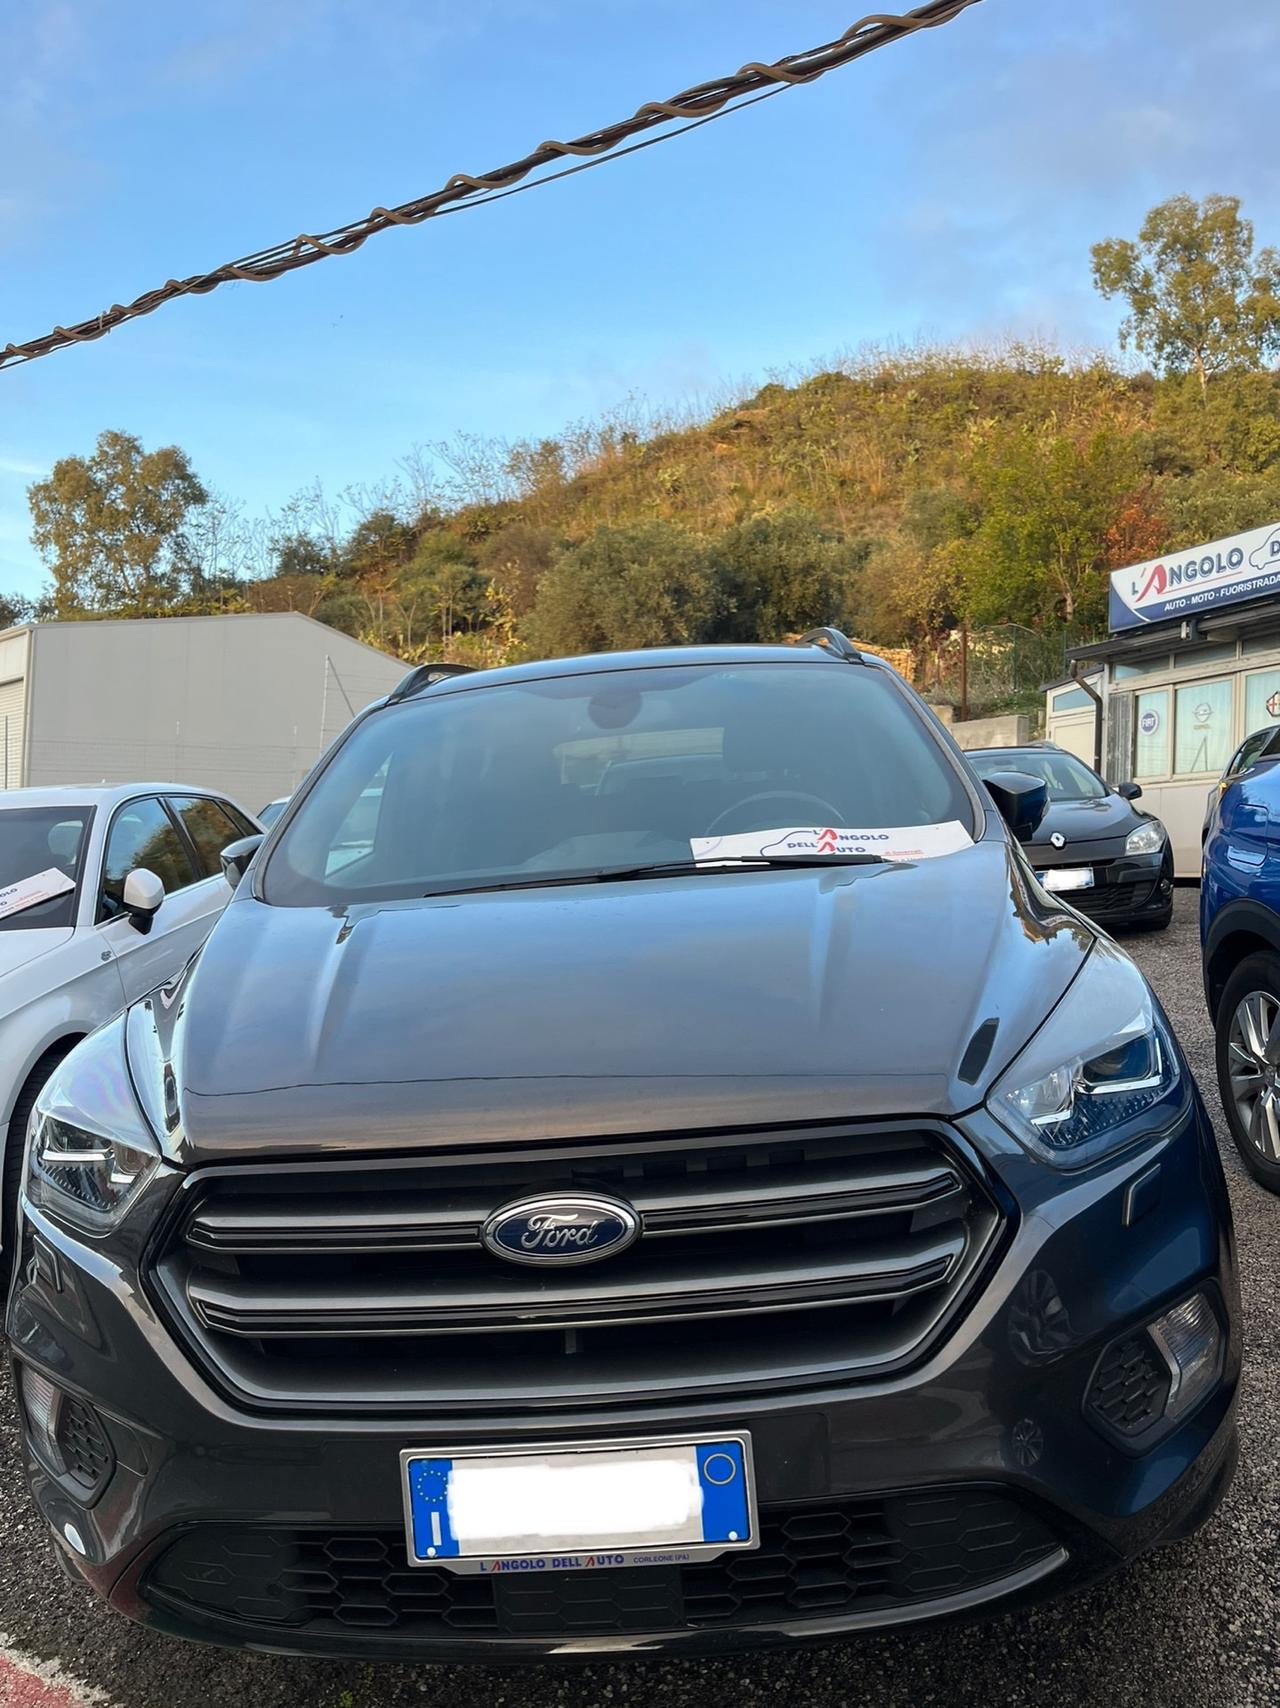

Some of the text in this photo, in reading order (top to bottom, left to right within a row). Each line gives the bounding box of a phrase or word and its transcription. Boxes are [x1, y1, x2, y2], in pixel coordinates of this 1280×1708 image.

[1164, 600, 1186, 611] AUTO
[1191, 591, 1214, 604] MOTO
[520, 1213, 598, 1249] Ford
[633, 1554, 674, 1564] CORLEONE
